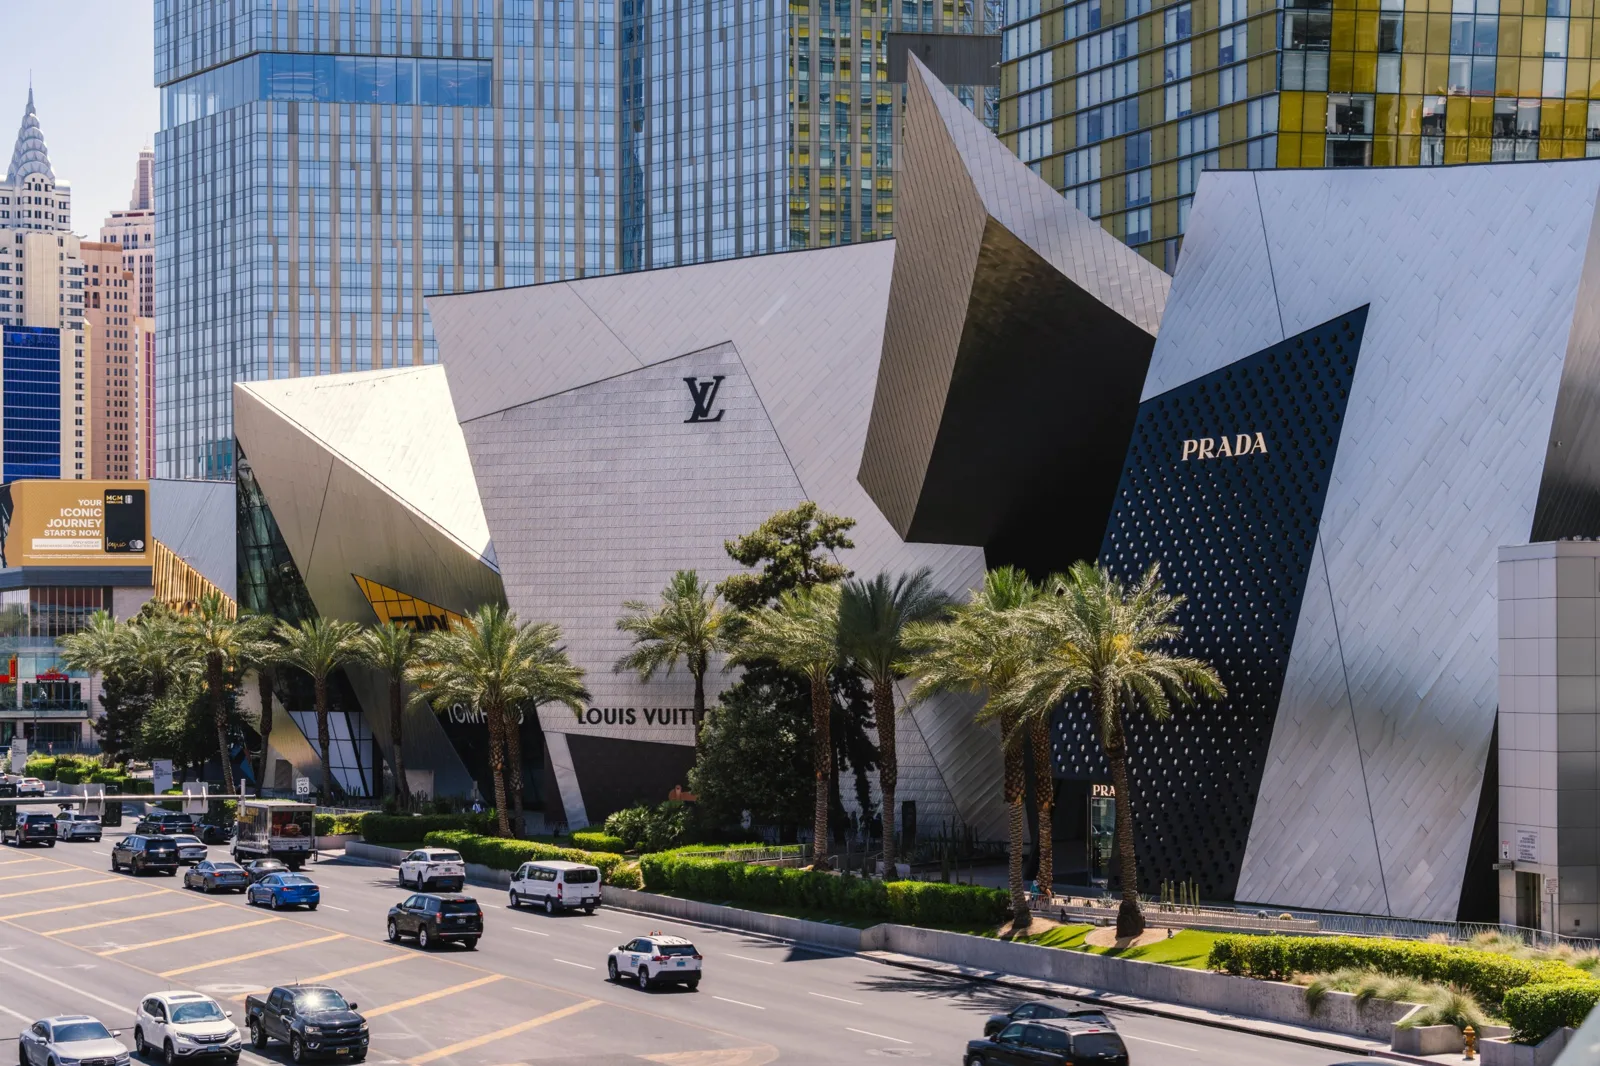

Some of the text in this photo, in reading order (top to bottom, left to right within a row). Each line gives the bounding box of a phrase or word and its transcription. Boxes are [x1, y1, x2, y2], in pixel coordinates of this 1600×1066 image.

[1181, 431, 1268, 461] PRADA
[60, 508, 102, 517] ICONIC
[46, 519, 102, 528] JOURNEY
[44, 529, 102, 537] STARTS NOW.
[578, 707, 710, 725] LOUIS VUITT
[1092, 784, 1116, 797] PRA
